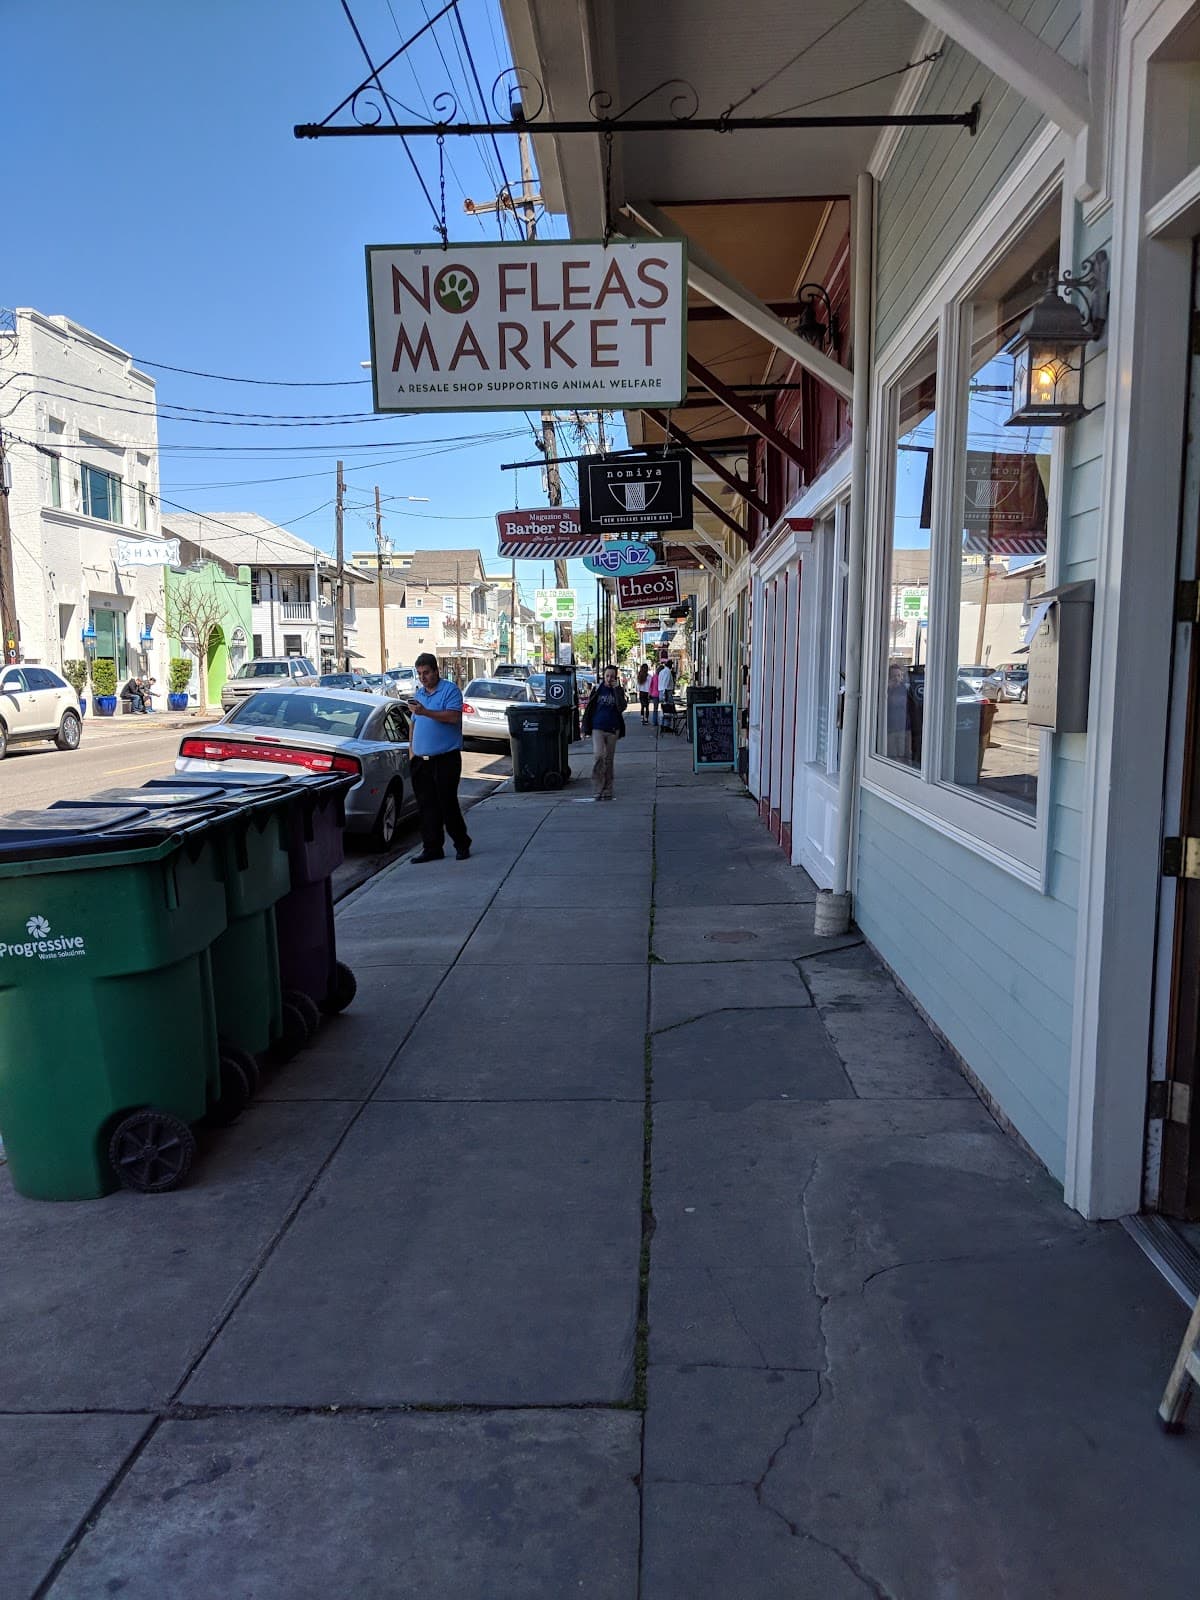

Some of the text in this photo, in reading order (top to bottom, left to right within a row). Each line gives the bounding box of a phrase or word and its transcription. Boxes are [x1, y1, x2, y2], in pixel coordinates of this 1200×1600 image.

[391, 257, 669, 315] NO FLEAS
[391, 317, 667, 373] MARKET
[398, 378, 662, 393] A RESALE SHOP SUPPORTING ANIMAL WELFARE
[607, 467, 662, 478] nomiya
[529, 513, 561, 522] Magazine
[505, 520, 581, 535] Barber Sh
[126, 548, 170, 559] SHAYA
[593, 546, 650, 571] TRENDZ
[621, 576, 674, 597] theo's
[536, 590, 548, 598] PAY
[549, 590, 557, 598] TO
[543, 598, 549, 606] 2
[553, 686, 562, 697] P
[0, 935, 84, 958] Progressive
[38, 949, 86, 961] Waste Solutions
